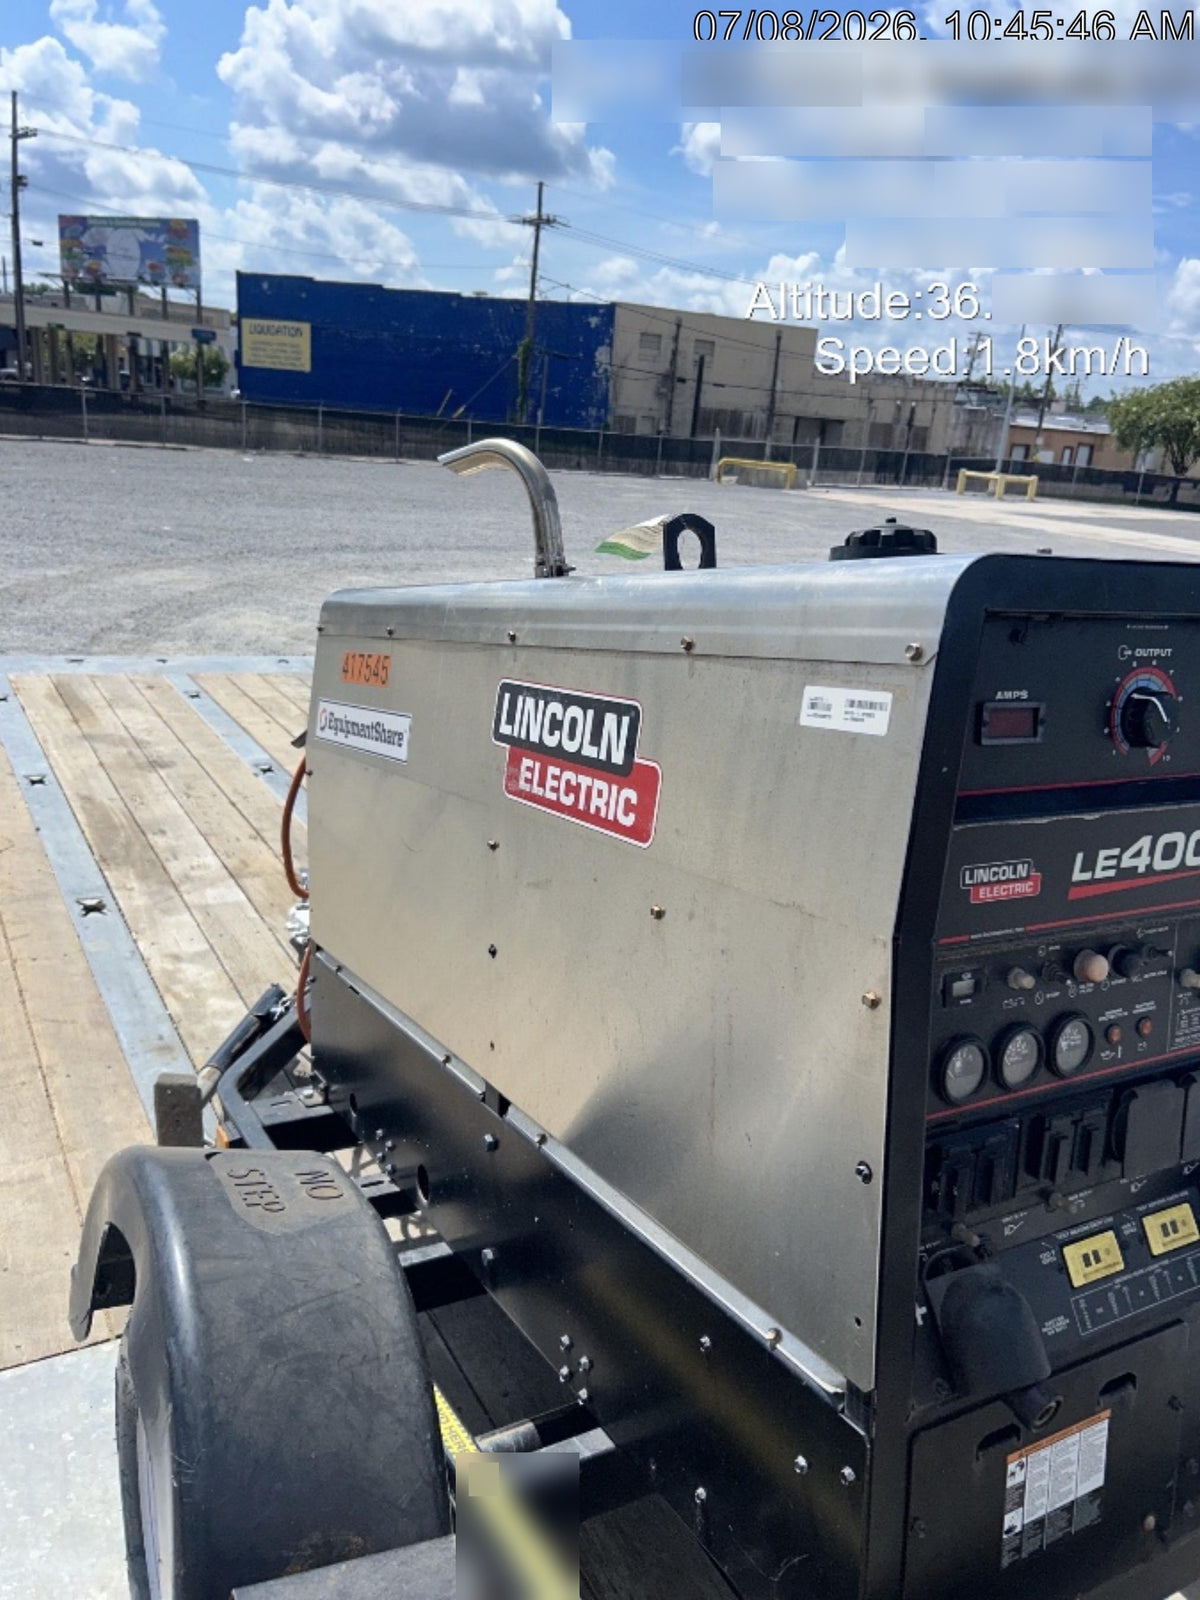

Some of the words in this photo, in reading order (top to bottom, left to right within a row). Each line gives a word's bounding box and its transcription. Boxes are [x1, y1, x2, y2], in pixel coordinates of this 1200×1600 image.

[342, 652, 391, 686] 417545
[1134, 648, 1173, 658] OUTPUT
[995, 689, 1029, 700] AMPS
[328, 711, 405, 748] EquipmentShare
[499, 692, 630, 766] LINCOLN
[518, 757, 638, 828] ELECTRIC
[964, 863, 1029, 884] LINCOLN
[978, 881, 1034, 899] ELECTRIC
[227, 1168, 287, 1213] STEP
[294, 1170, 344, 1200] NO
